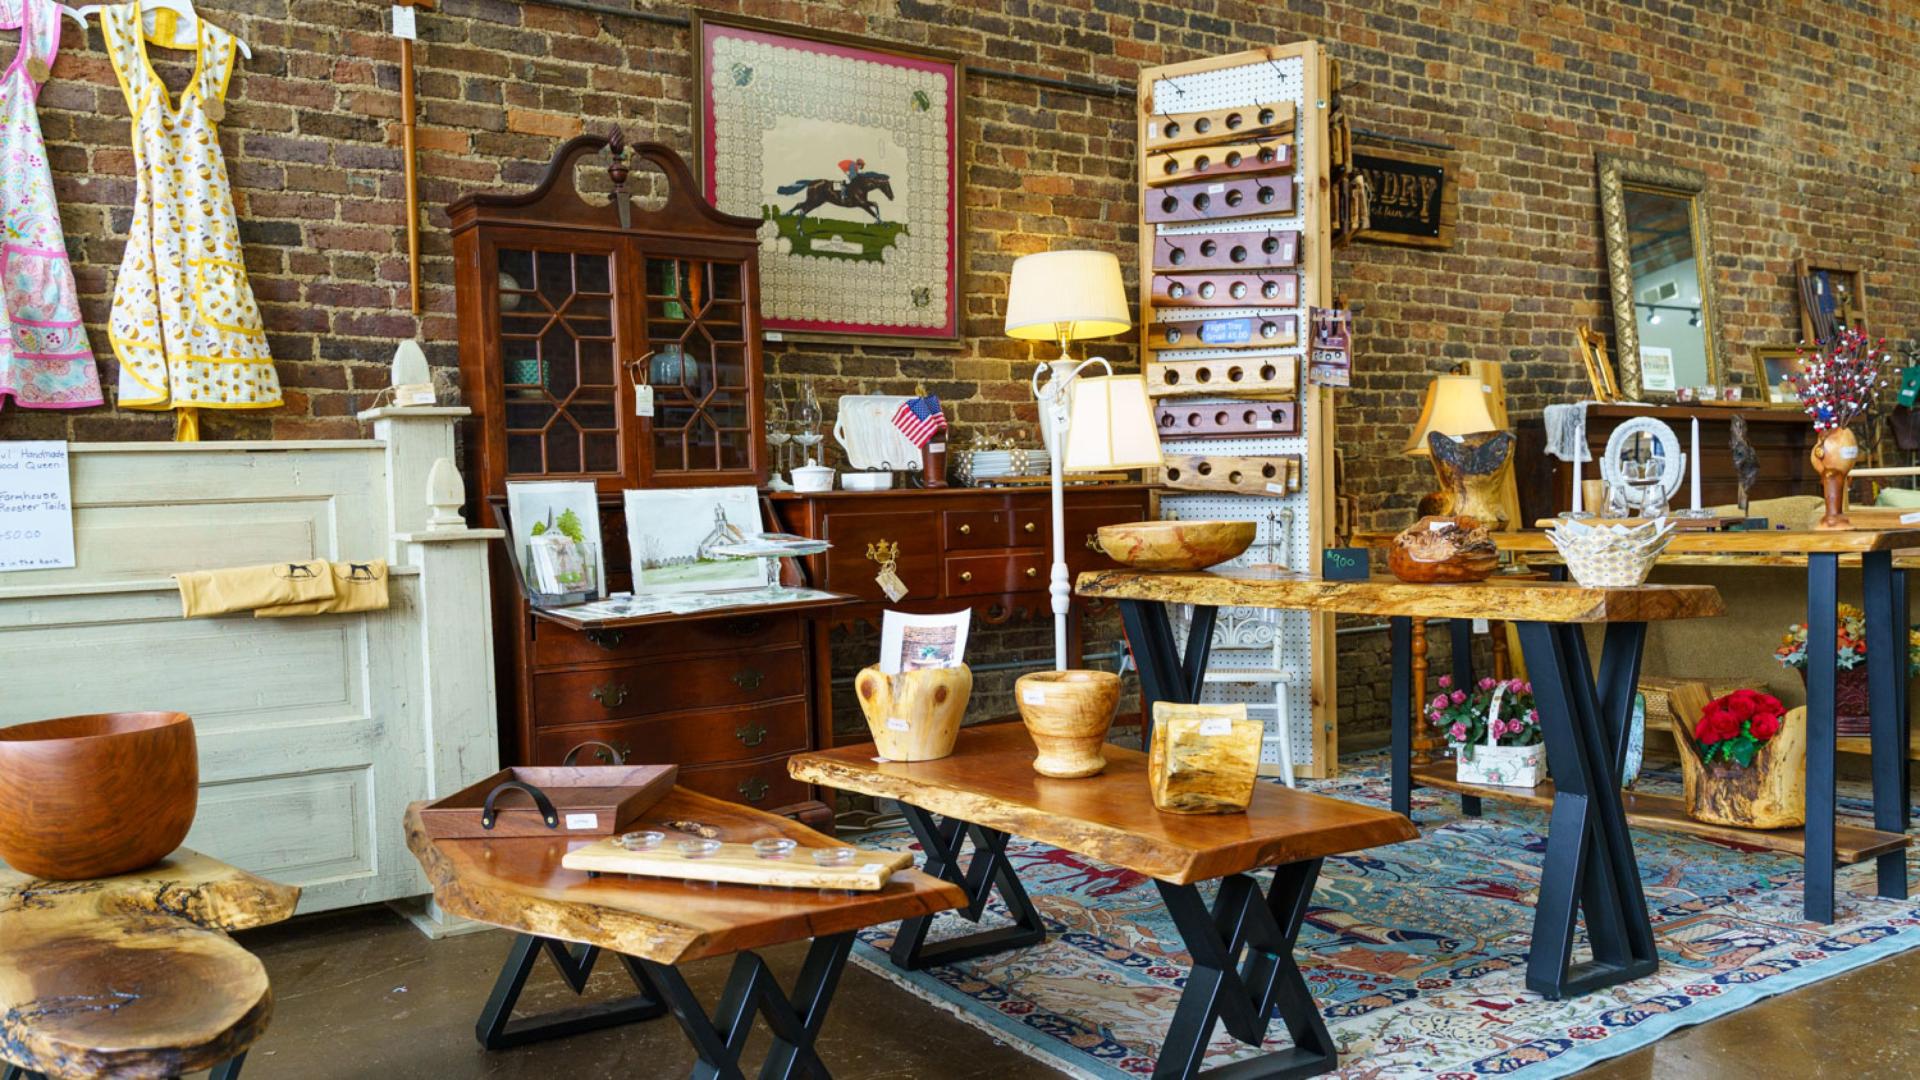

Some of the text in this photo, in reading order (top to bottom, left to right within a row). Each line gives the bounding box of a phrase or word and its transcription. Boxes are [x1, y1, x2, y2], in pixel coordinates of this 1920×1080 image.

[21, 449, 65, 459] Handmade
[25, 461, 60, 469] Queen
[41, 500, 67, 510] Tails
